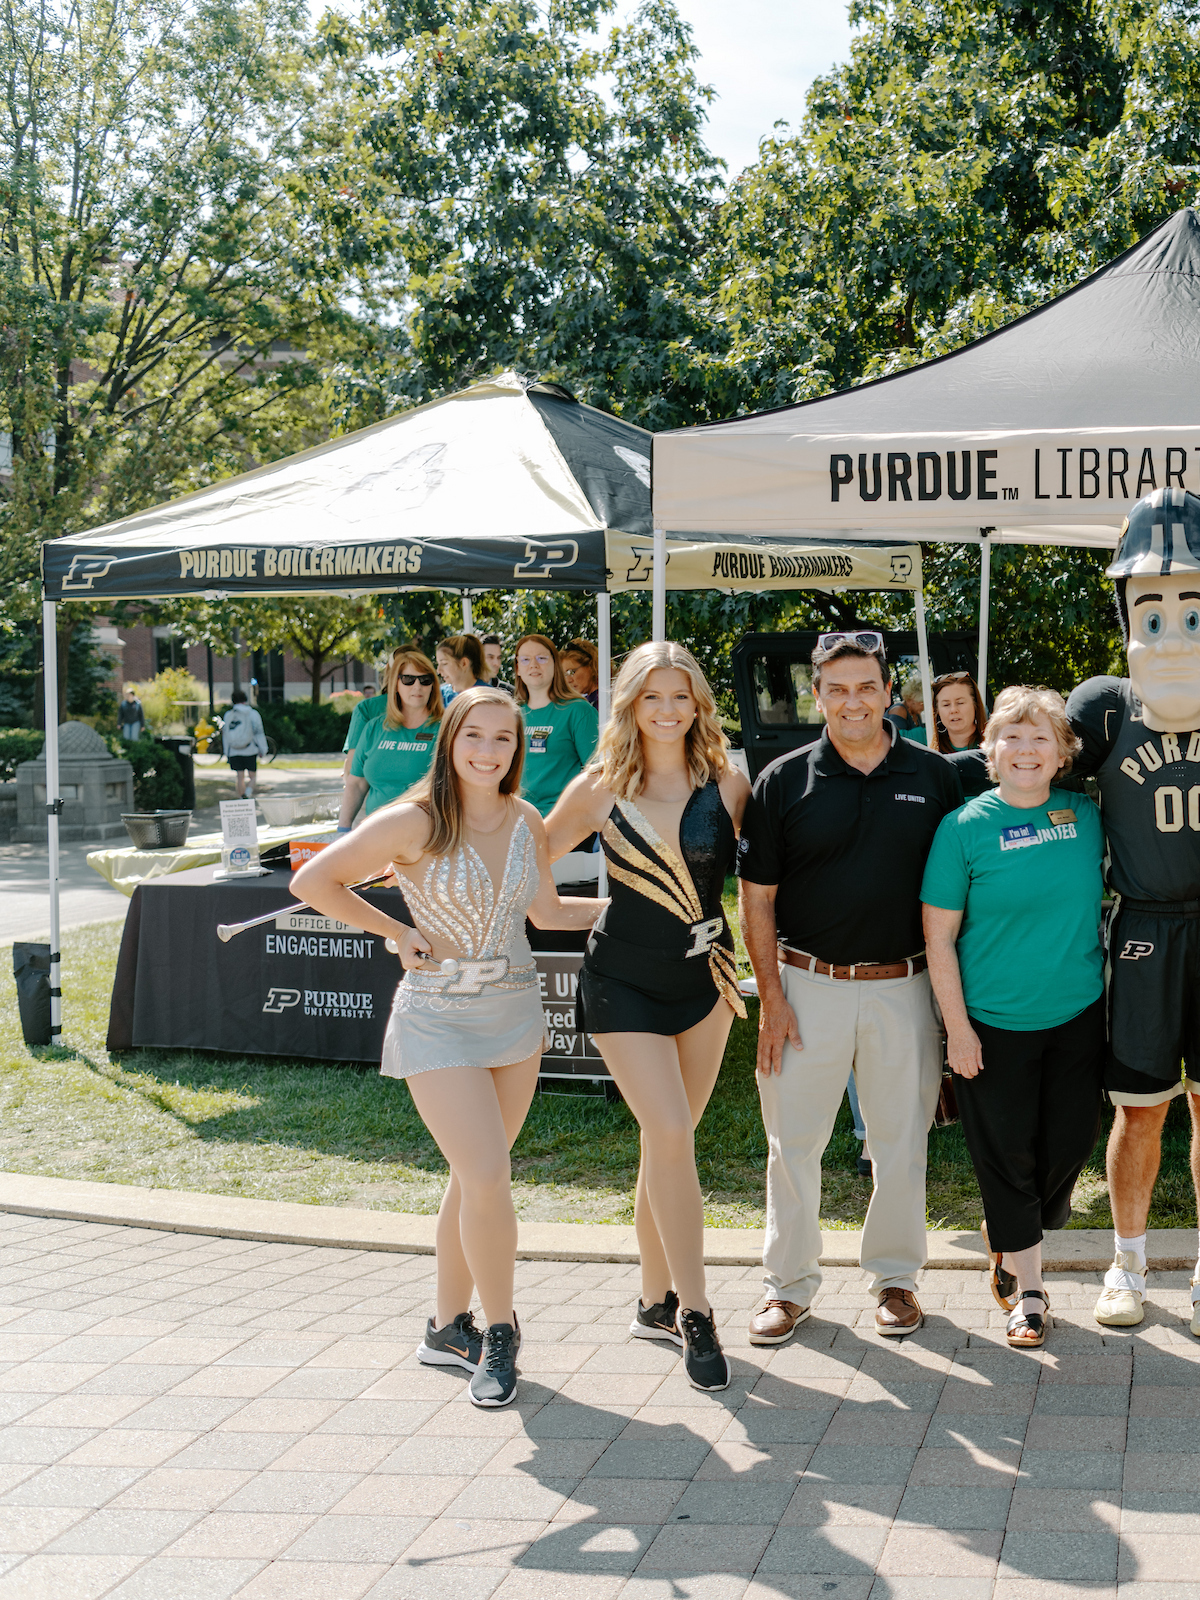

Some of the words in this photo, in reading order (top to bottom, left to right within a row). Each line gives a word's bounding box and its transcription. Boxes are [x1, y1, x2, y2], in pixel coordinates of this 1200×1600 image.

[830, 449, 998, 502] PURDUE
[179, 550, 257, 578] PURDUE
[263, 545, 423, 577] BOILERMAKERS
[711, 552, 767, 579] PURDUE
[768, 555, 853, 578] BOILERMAKERS
[378, 740, 397, 750] LIVE
[397, 741, 428, 752] UNITED
[894, 793, 907, 801] LIVE
[907, 794, 926, 804] UNITED
[1009, 829, 1020, 839] I'm
[290, 917, 331, 930] OFFICE
[335, 919, 350, 930] OF
[266, 934, 375, 959] ENGAGEMENT
[555, 972, 579, 997] UN
[304, 989, 373, 1010] PURDUE
[304, 1006, 373, 1019] UNIVERSITY
[545, 1009, 576, 1029] ted
